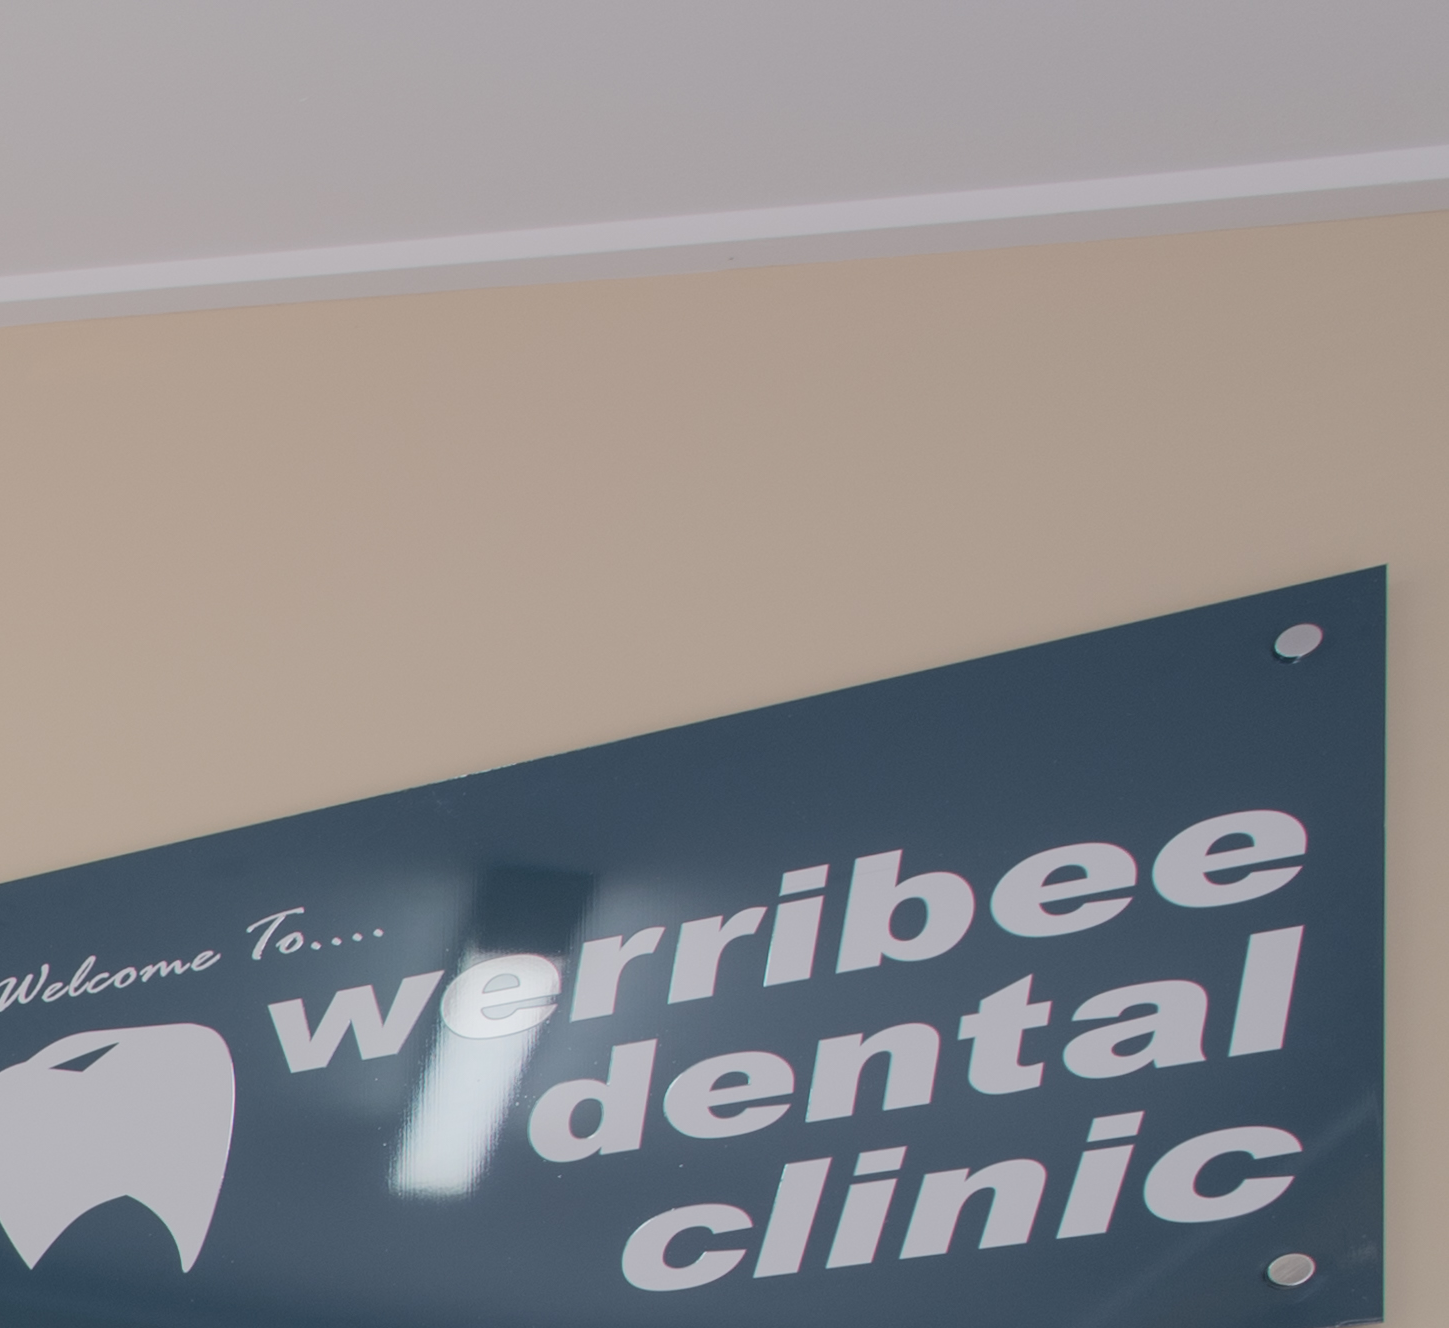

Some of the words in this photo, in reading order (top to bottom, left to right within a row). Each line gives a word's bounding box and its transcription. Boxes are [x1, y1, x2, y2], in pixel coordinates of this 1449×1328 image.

[266, 808, 1310, 1074] werribee
[526, 924, 1305, 1163] dental
[619, 1110, 1304, 1293] clinic
